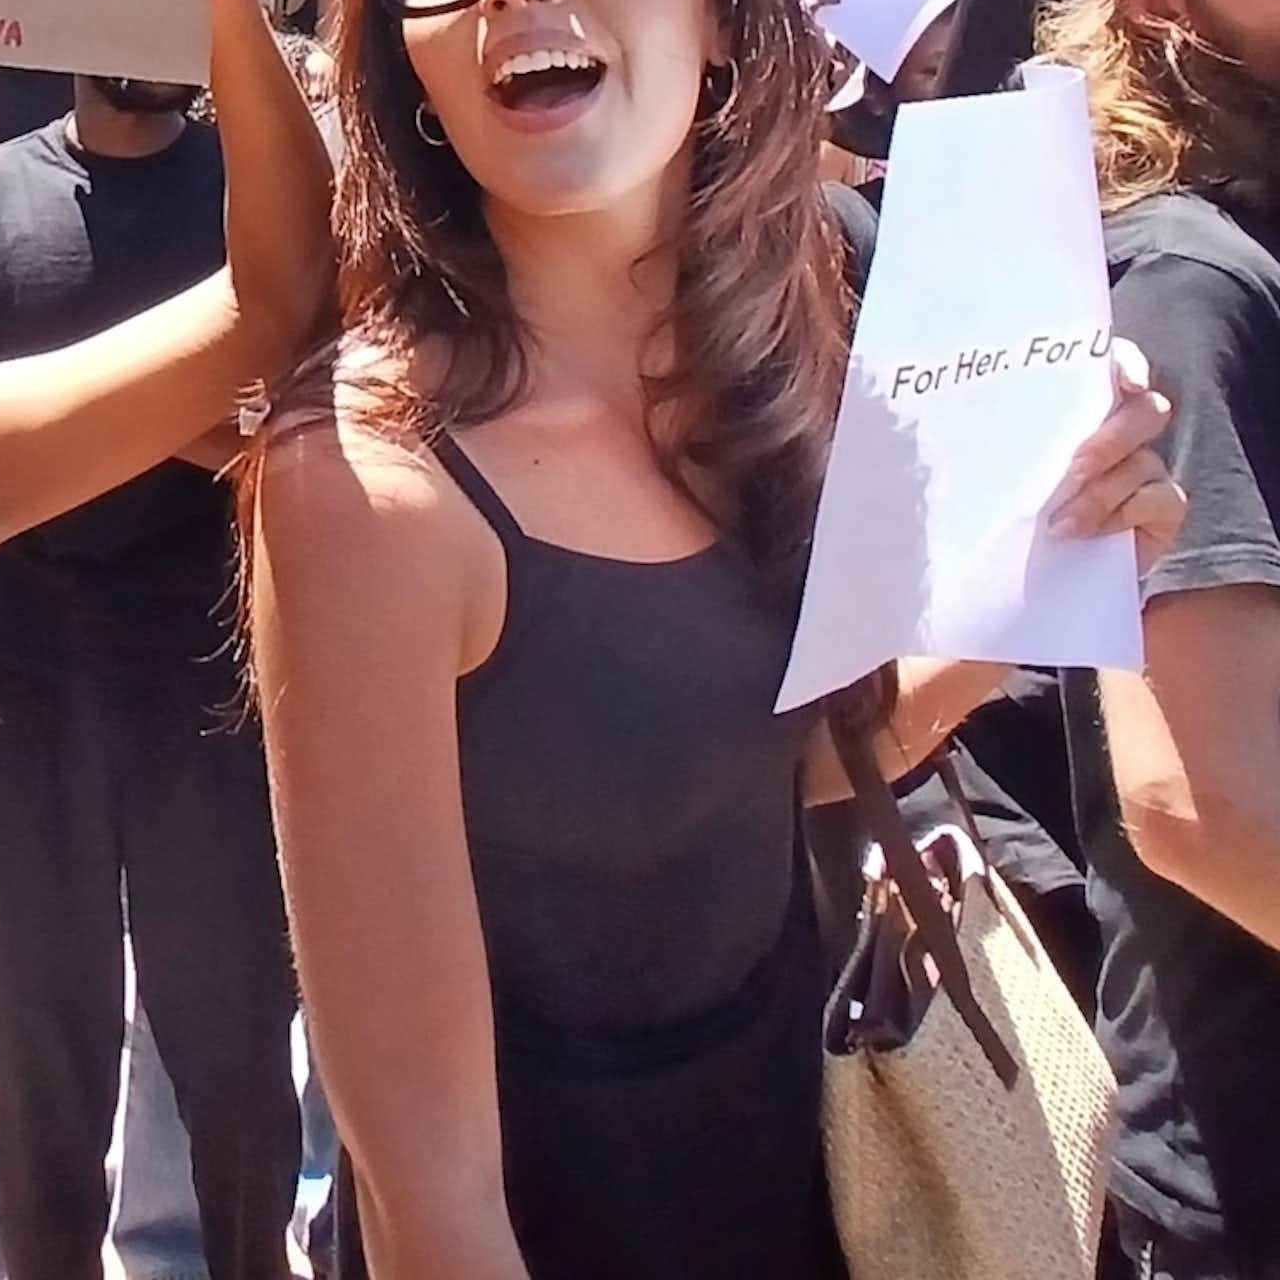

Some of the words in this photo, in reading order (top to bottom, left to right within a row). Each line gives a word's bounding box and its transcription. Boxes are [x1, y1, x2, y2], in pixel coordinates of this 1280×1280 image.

[890, 365, 948, 399] For
[954, 348, 1009, 384] Her.
[1023, 336, 1081, 367] For
